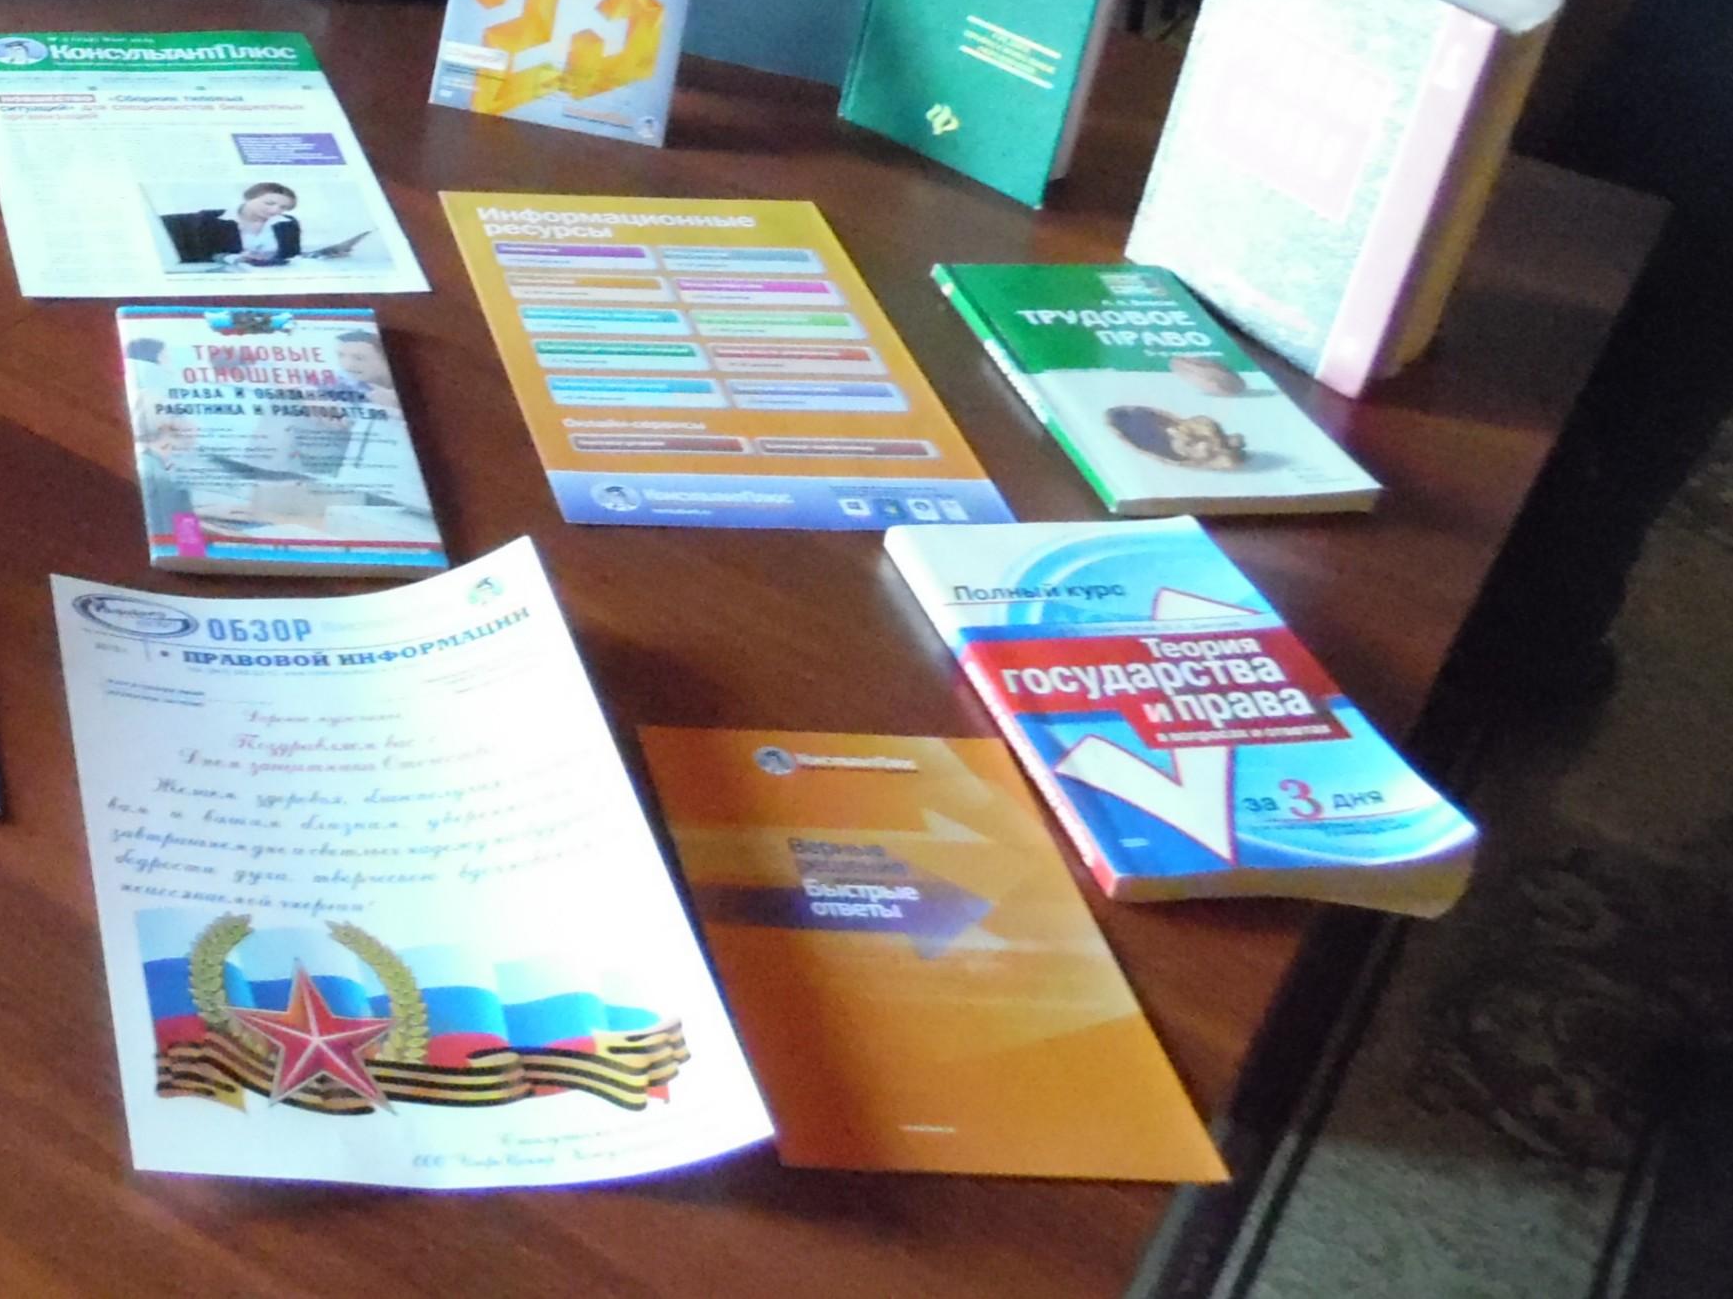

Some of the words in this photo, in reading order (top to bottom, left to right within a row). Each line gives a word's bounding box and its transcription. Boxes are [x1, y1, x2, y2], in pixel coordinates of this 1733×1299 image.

[476, 205, 757, 230] Информационные
[482, 220, 614, 242] ресурсы
[1016, 308, 1197, 328] ТРУДОВОЕ
[1095, 330, 1212, 348] ПРАВО
[192, 344, 326, 364] ТРУДОВЫЕ
[182, 366, 338, 387] ОТНОШЕНИЯ
[168, 387, 224, 401] ПРАВА
[155, 403, 245, 416] РАБОТНИКА
[271, 404, 389, 421] РАБОТОДАТЕЛЯ
[953, 584, 1061, 602] Полный
[1065, 584, 1127, 602] курс
[182, 648, 330, 668] ПРАВОВОЙ
[337, 605, 532, 667] ИНФОРМАЦИИ
[207, 617, 313, 642] ОБЗОР
[1140, 637, 1262, 661] Теория
[1000, 656, 1286, 700] государства
[1142, 702, 1174, 723] и
[1172, 688, 1316, 729] права
[1242, 797, 1280, 812] за
[1278, 778, 1325, 820] 3
[1332, 790, 1385, 812] дня
[801, 877, 921, 903] Быстрые
[809, 901, 904, 919] ответы
